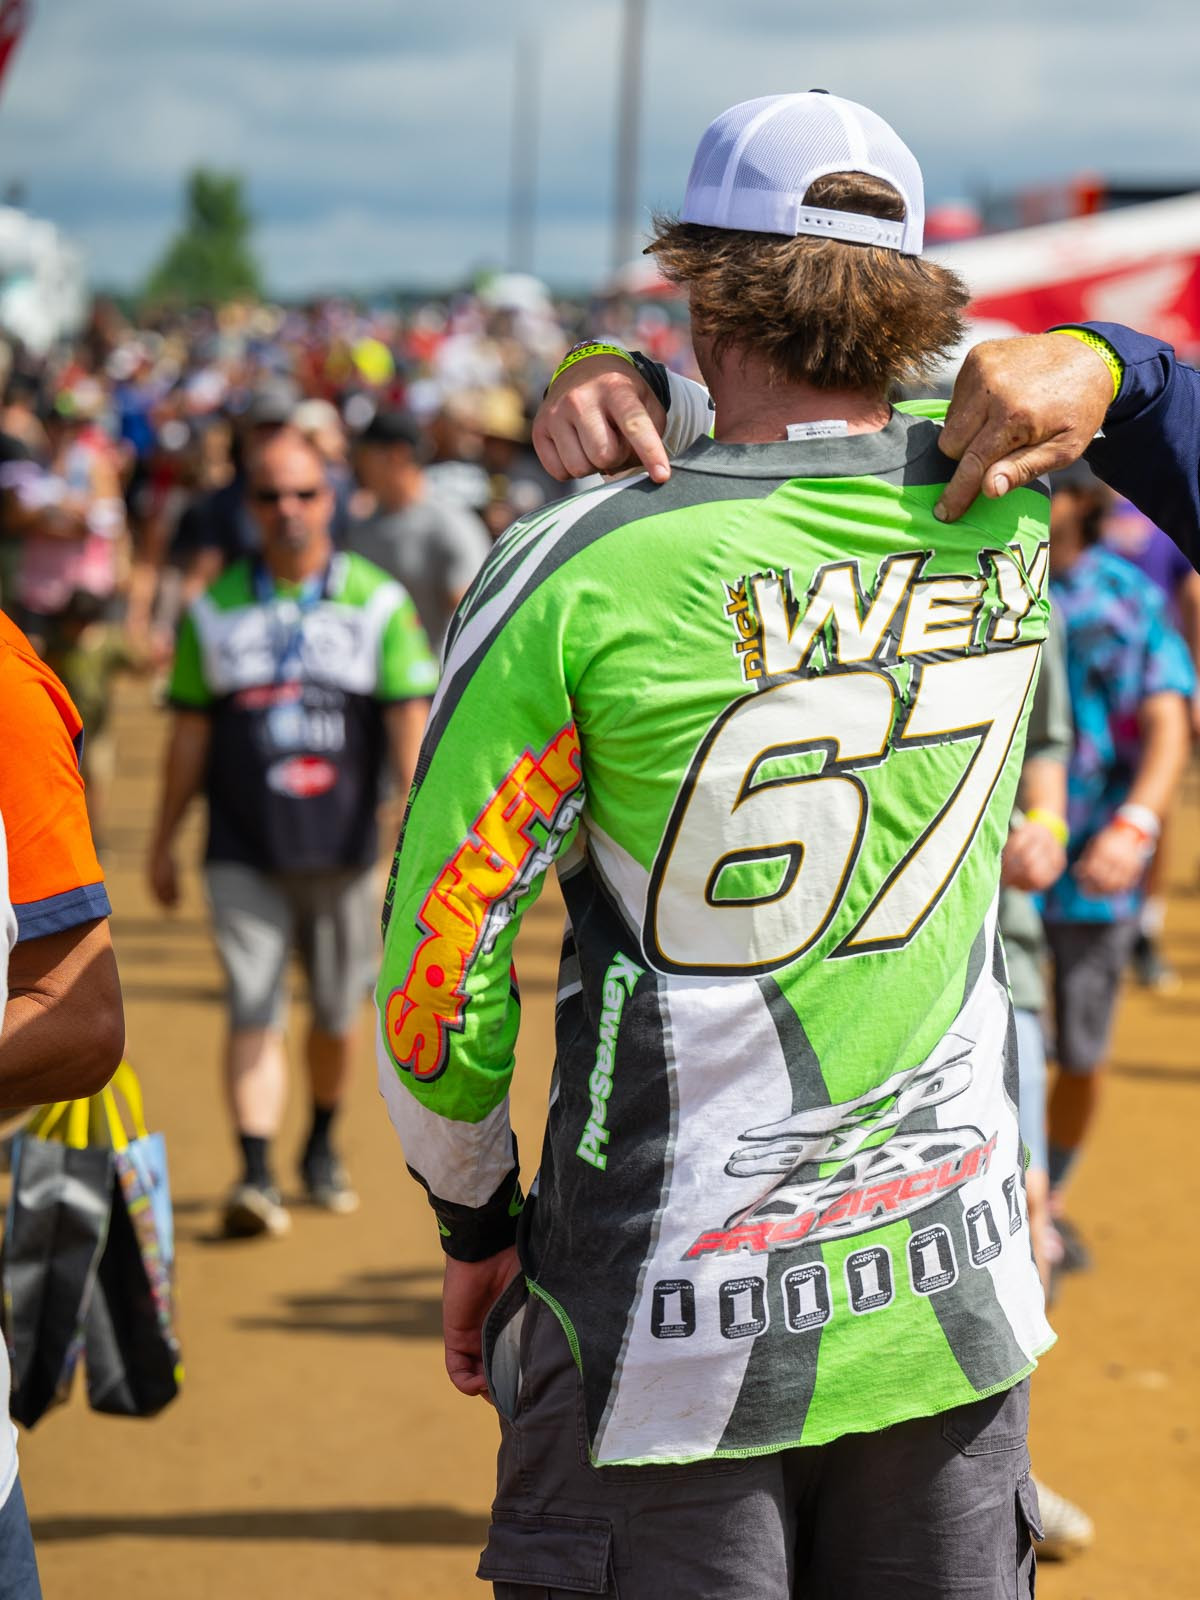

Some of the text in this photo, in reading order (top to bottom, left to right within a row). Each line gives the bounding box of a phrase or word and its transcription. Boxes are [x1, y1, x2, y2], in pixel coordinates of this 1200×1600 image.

[728, 584, 764, 681] nick
[641, 643, 1043, 977] 67
[384, 720, 583, 1076] SplitFir
[576, 951, 646, 1171] Kawasaki
[680, 1211, 818, 1261] PRO
[910, 1230, 945, 1247] McGRATH
[973, 1212, 996, 1253] 1
[790, 1270, 821, 1283] PICHON
[854, 1259, 884, 1299] 1
[917, 1239, 947, 1281] 1
[724, 1281, 760, 1291] PICHON
[794, 1277, 822, 1317] 1
[659, 1290, 687, 1326] 1
[728, 1288, 758, 1327] 1
